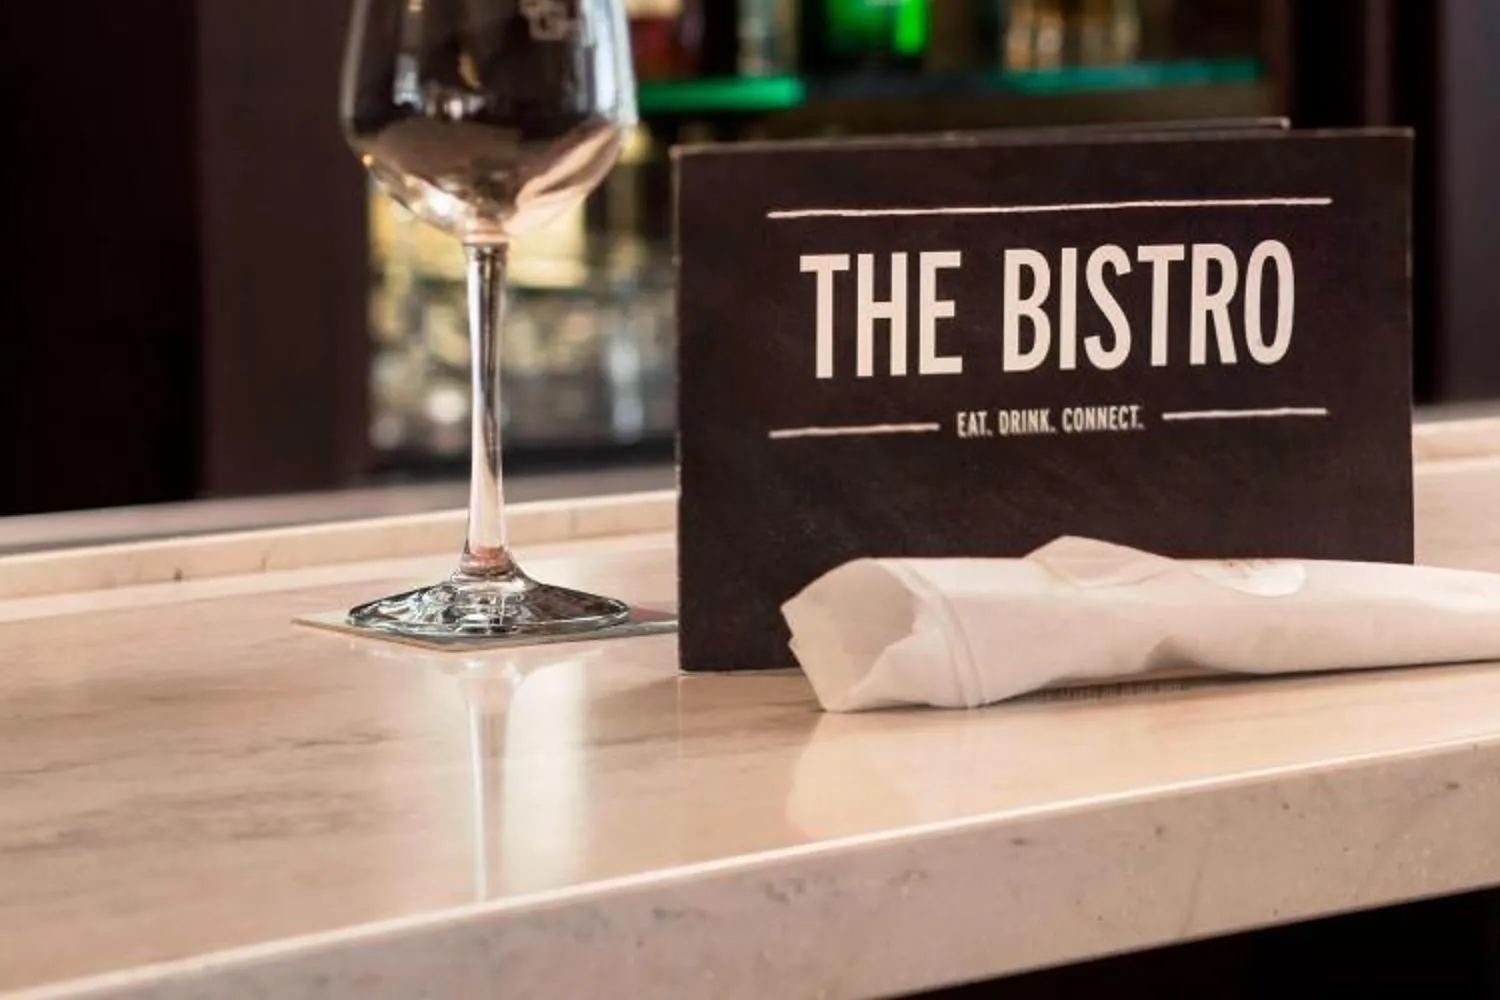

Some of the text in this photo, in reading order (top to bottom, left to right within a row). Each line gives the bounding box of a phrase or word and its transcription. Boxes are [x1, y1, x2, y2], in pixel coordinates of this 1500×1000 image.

[799, 239, 1295, 379] THE BISTRO
[956, 404, 1145, 438] EAT. DRINK. CONNECT.
